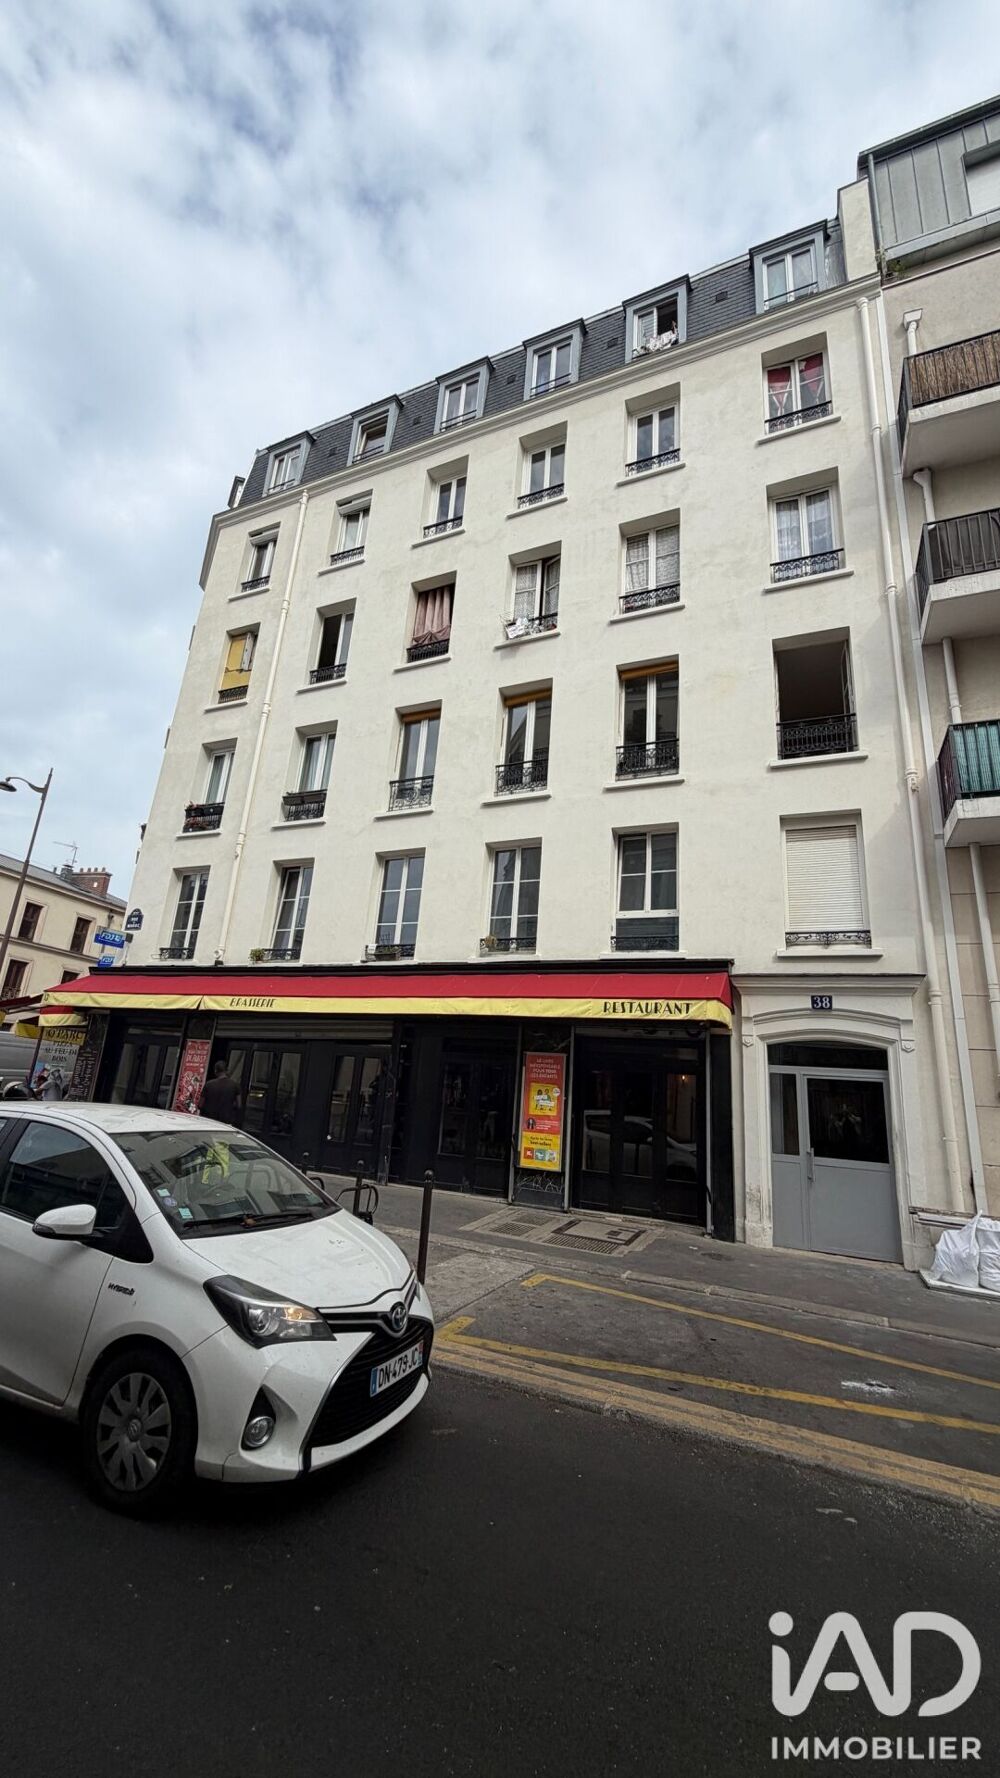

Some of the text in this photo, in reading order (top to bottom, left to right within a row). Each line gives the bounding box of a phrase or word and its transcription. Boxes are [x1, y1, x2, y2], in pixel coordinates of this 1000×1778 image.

[230, 997, 275, 1008] BRASSERIE
[603, 1001, 692, 1014] RESTAURANT
[813, 996, 831, 1009] 38
